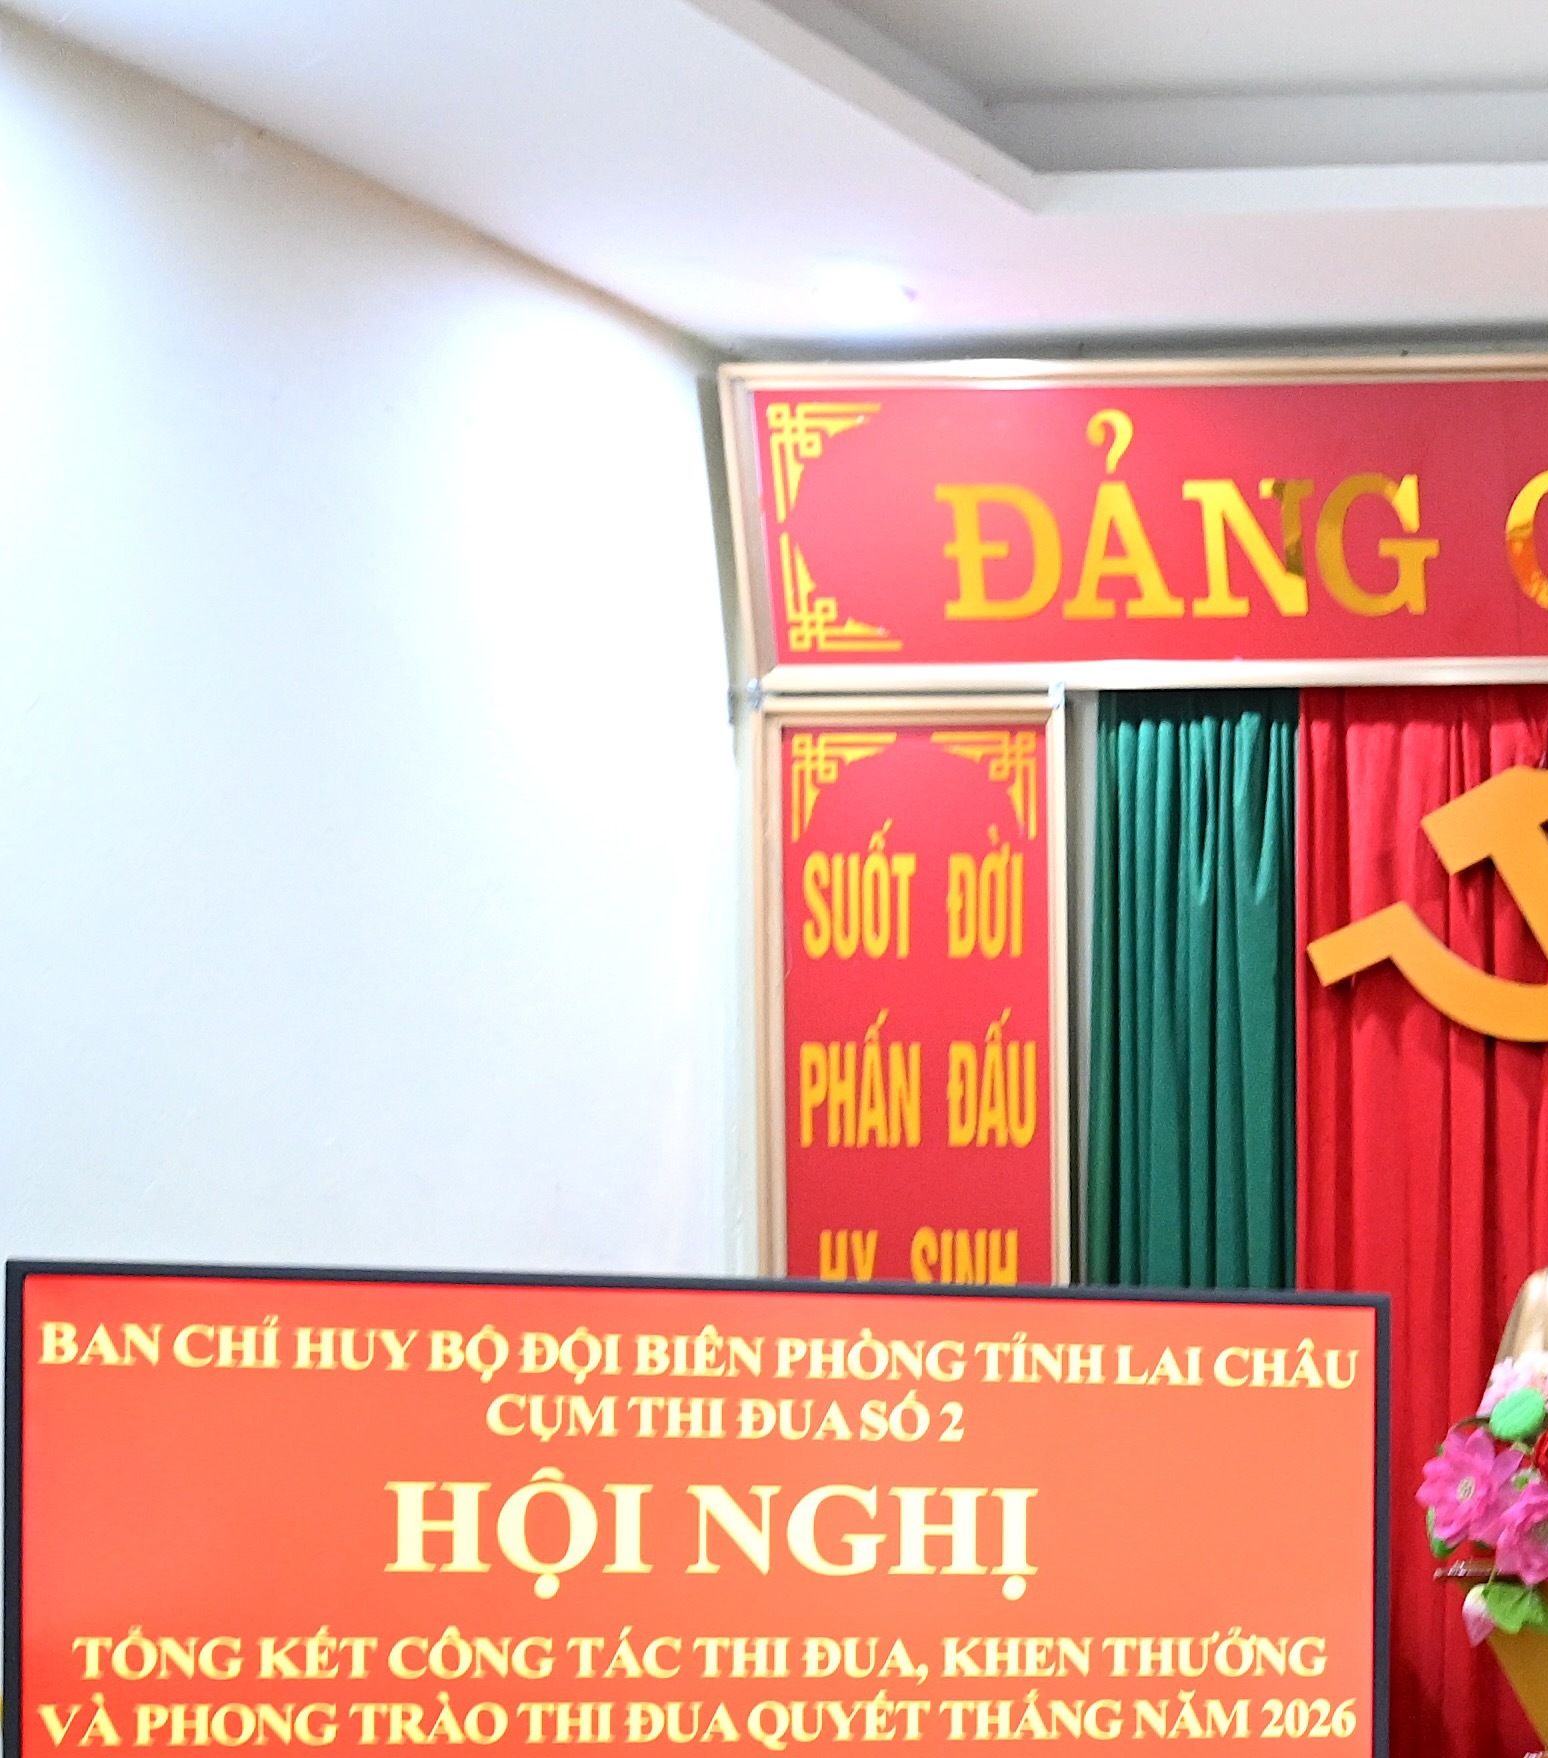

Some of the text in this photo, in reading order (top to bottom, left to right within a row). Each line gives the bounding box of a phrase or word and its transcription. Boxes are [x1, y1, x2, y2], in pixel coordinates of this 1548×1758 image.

[934, 409, 1440, 619] ĐẢNG
[803, 819, 1023, 959] SUỐT ĐỜI
[800, 1008, 1037, 1147] PHẤN ĐẤU
[38, 1321, 164, 1367] BAN
[291, 1326, 419, 1372] HUY
[426, 1324, 510, 1383] BỘ
[518, 1325, 622, 1385] ĐỘI
[633, 1323, 765, 1378] BIÊN
[1113, 1345, 1208, 1387] LAI
[1213, 1337, 1360, 1389] CHÂU
[485, 1393, 620, 1443] CỤM
[627, 1394, 728, 1439] THI
[735, 1397, 854, 1441] ĐUA
[938, 1401, 965, 1443] 2
[383, 1465, 1039, 1601] HỘI NGHỊ
[387, 1624, 556, 1680] CÔNG
[566, 1624, 682, 1679] TÁC
[693, 1636, 791, 1679] THI
[801, 1636, 929, 1685] ĐUA,
[940, 1636, 1094, 1678] KHEN
[1101, 1625, 1328, 1678] THƯỞNG
[132, 1702, 340, 1747] PHONG
[515, 1701, 616, 1744] THI
[624, 1701, 741, 1744] ĐUA
[1132, 1689, 1252, 1740] NĂM
[1260, 1698, 1357, 1739] 2026
